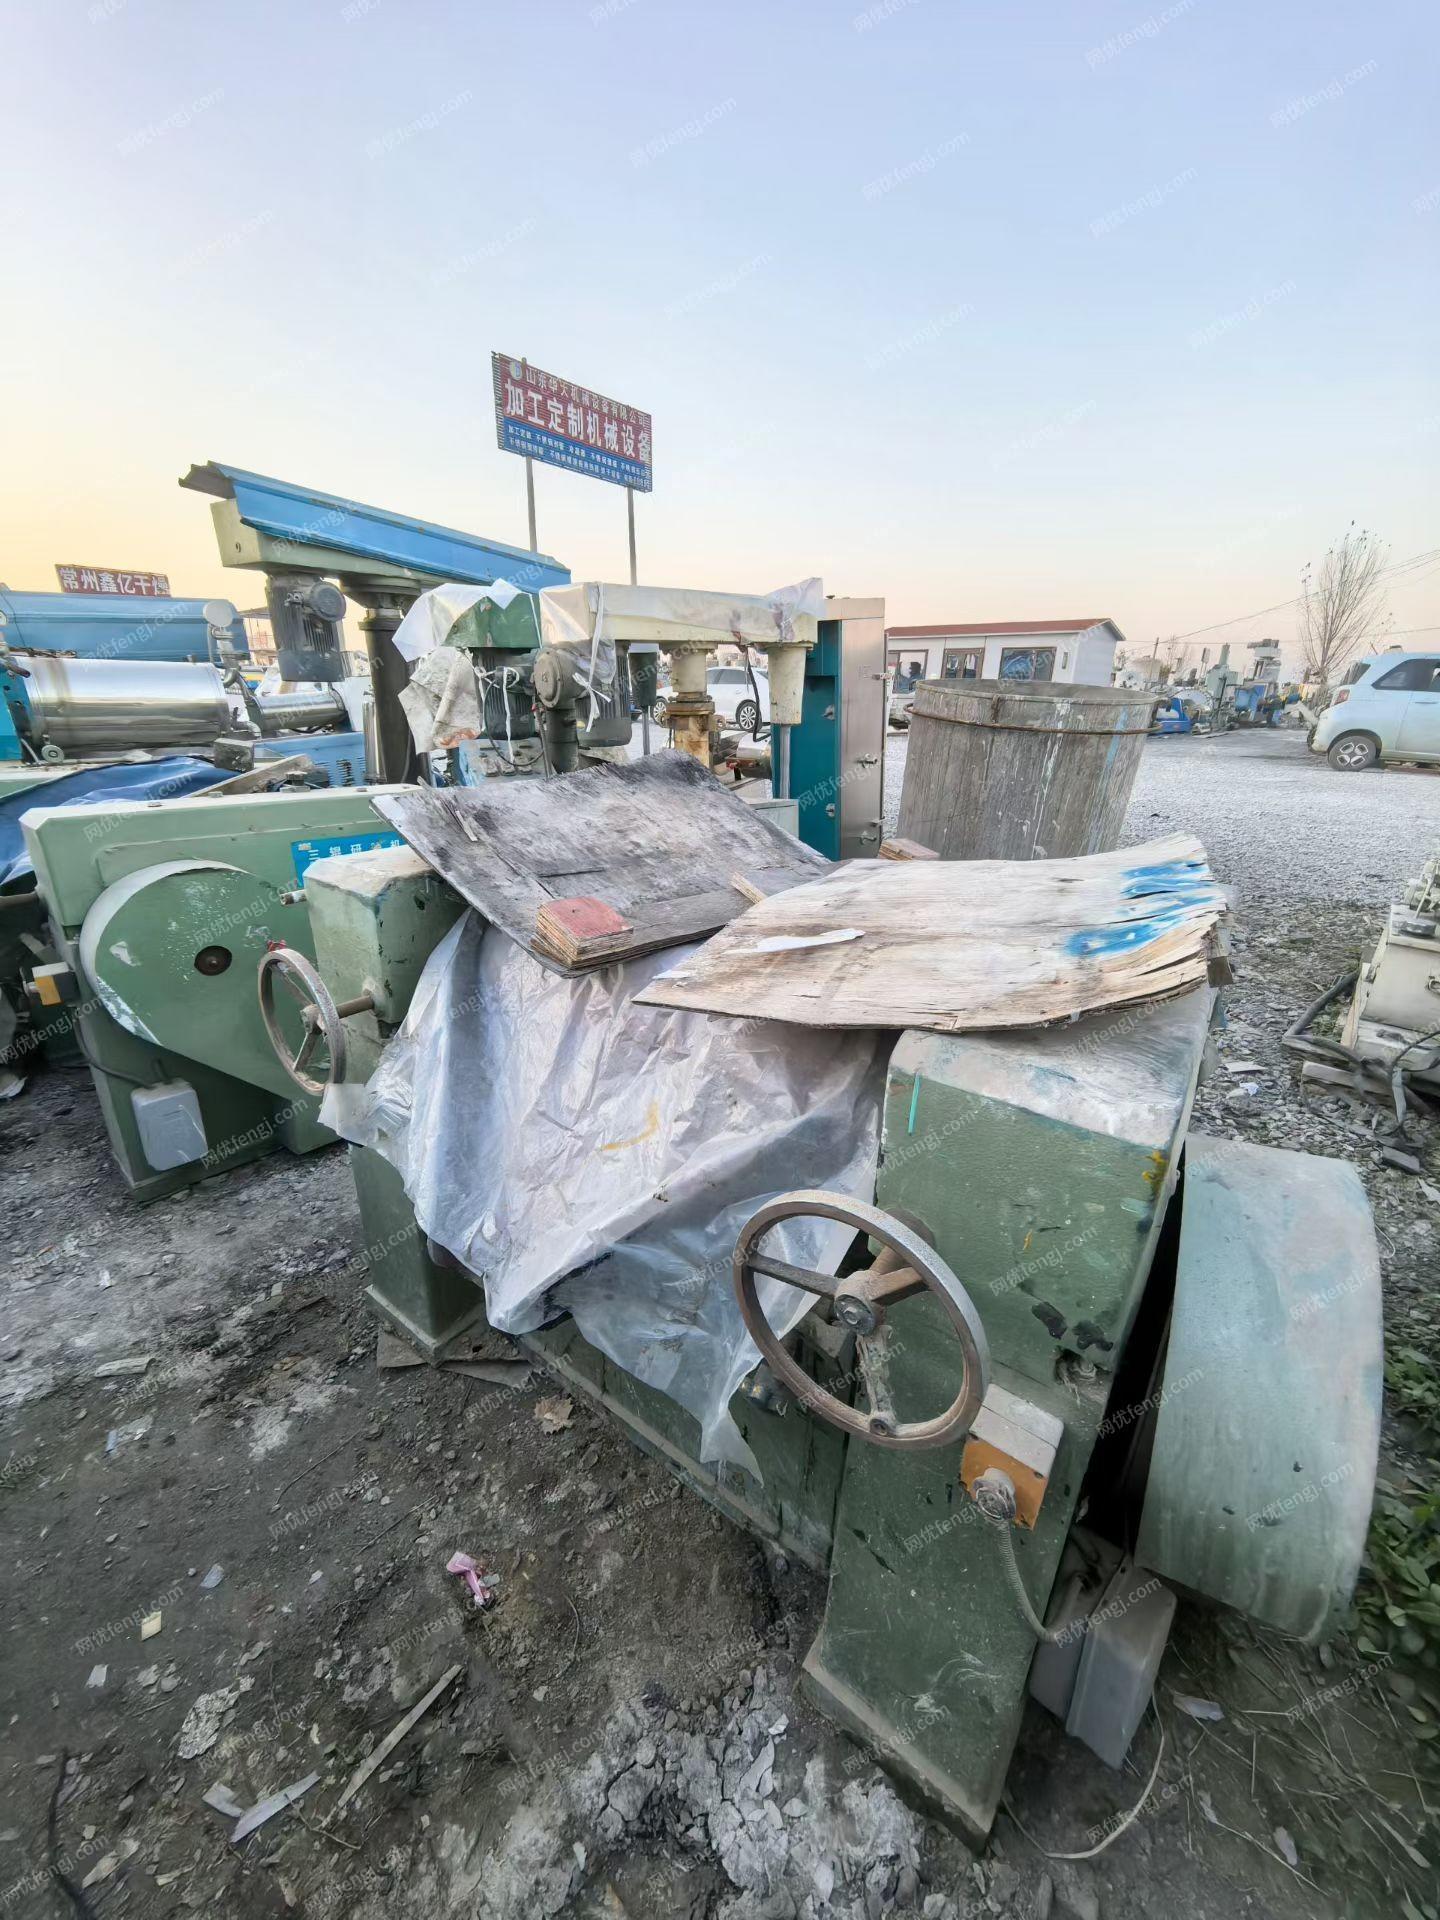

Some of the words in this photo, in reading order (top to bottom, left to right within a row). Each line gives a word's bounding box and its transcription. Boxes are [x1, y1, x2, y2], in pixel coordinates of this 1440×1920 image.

[504, 377, 651, 462] 加工定制机械设备
